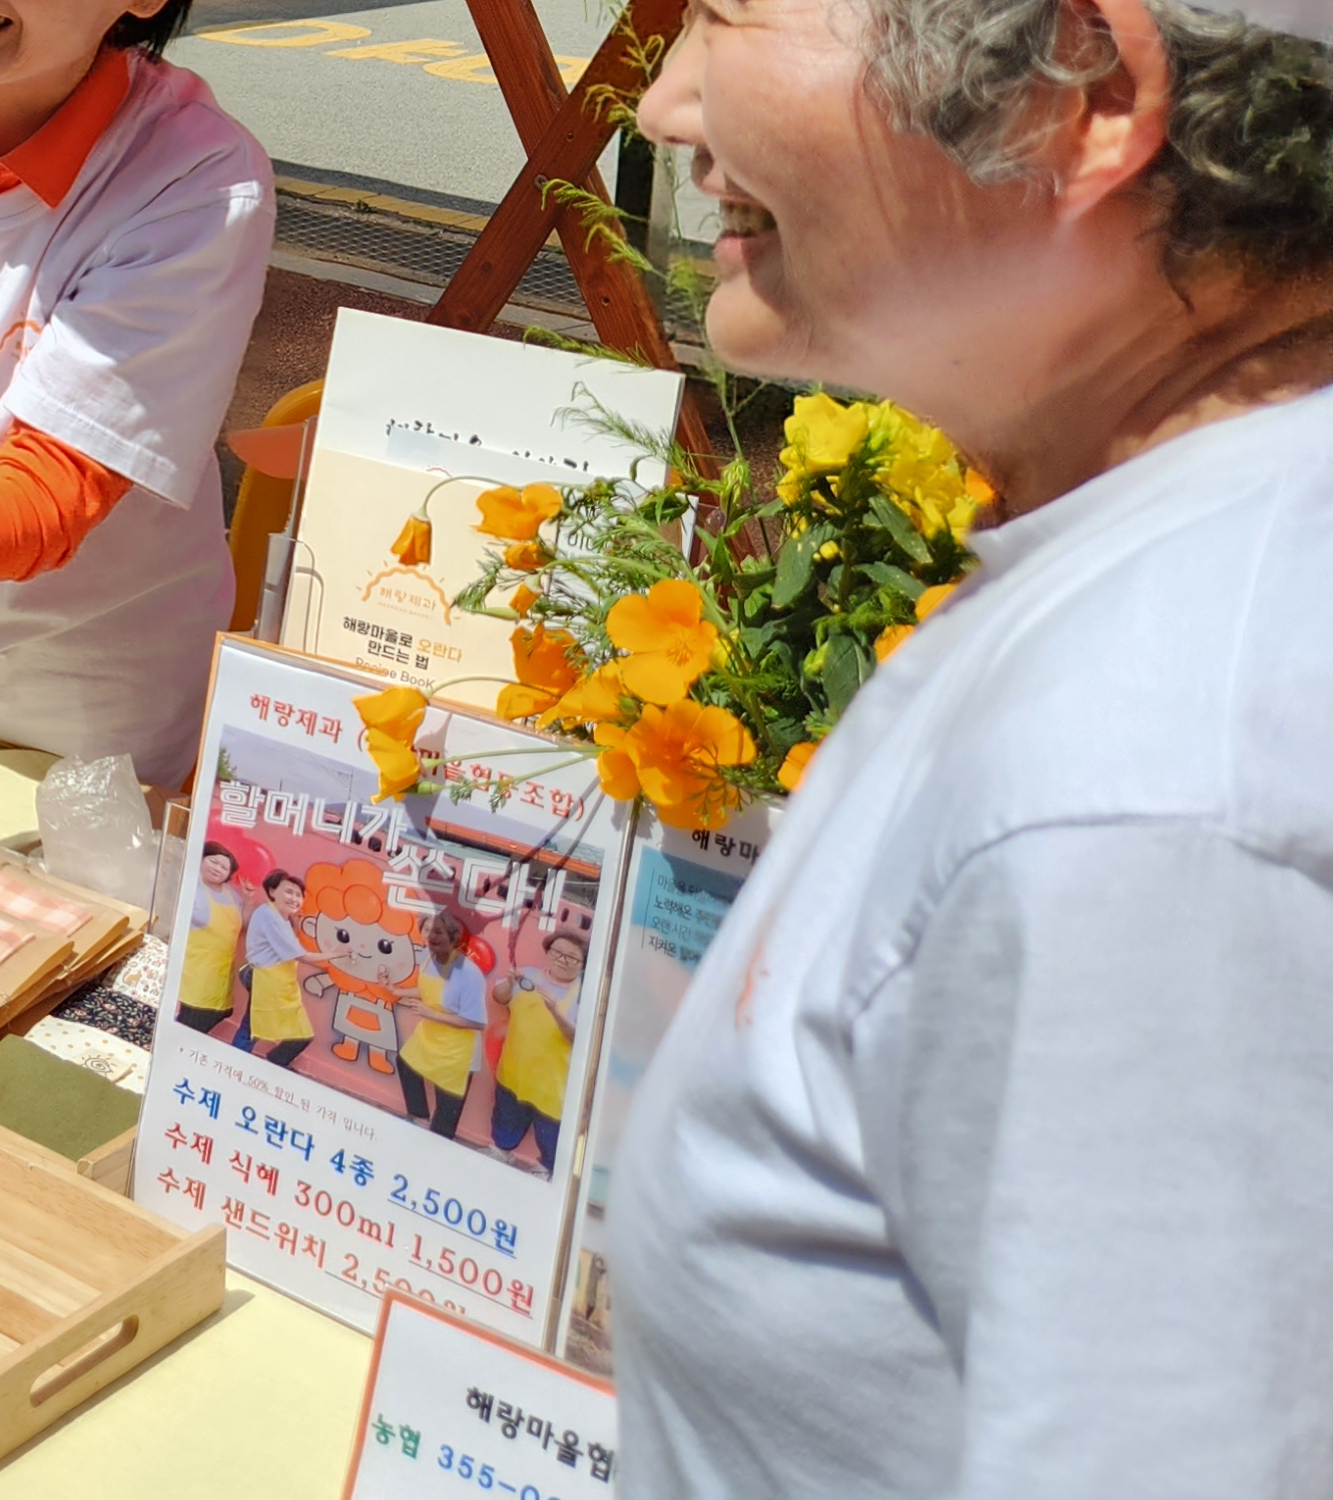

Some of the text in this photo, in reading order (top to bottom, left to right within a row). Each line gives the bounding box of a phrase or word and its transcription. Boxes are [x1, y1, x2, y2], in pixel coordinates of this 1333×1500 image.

[379, 587, 436, 611] 해랑제과
[343, 616, 462, 663] 해랑마을로 오란다
[367, 640, 430, 670] 만드는 법
[250, 693, 343, 743] 해랑제과
[219, 780, 408, 857] 할머니가
[213, 1060, 243, 1082] 가격에
[247, 1075, 269, 1093] 50%
[274, 1086, 294, 1104] 할인
[316, 1104, 337, 1124] 가격
[172, 1077, 517, 1255] 수제 오란다 4종 2,500원
[157, 1167, 206, 1211] 수제
[220, 1196, 327, 1269] 샌드위치
[164, 1122, 534, 1316] 수제 식혜 300ml 1,500원
[371, 1413, 562, 1500] 농협 355-0
